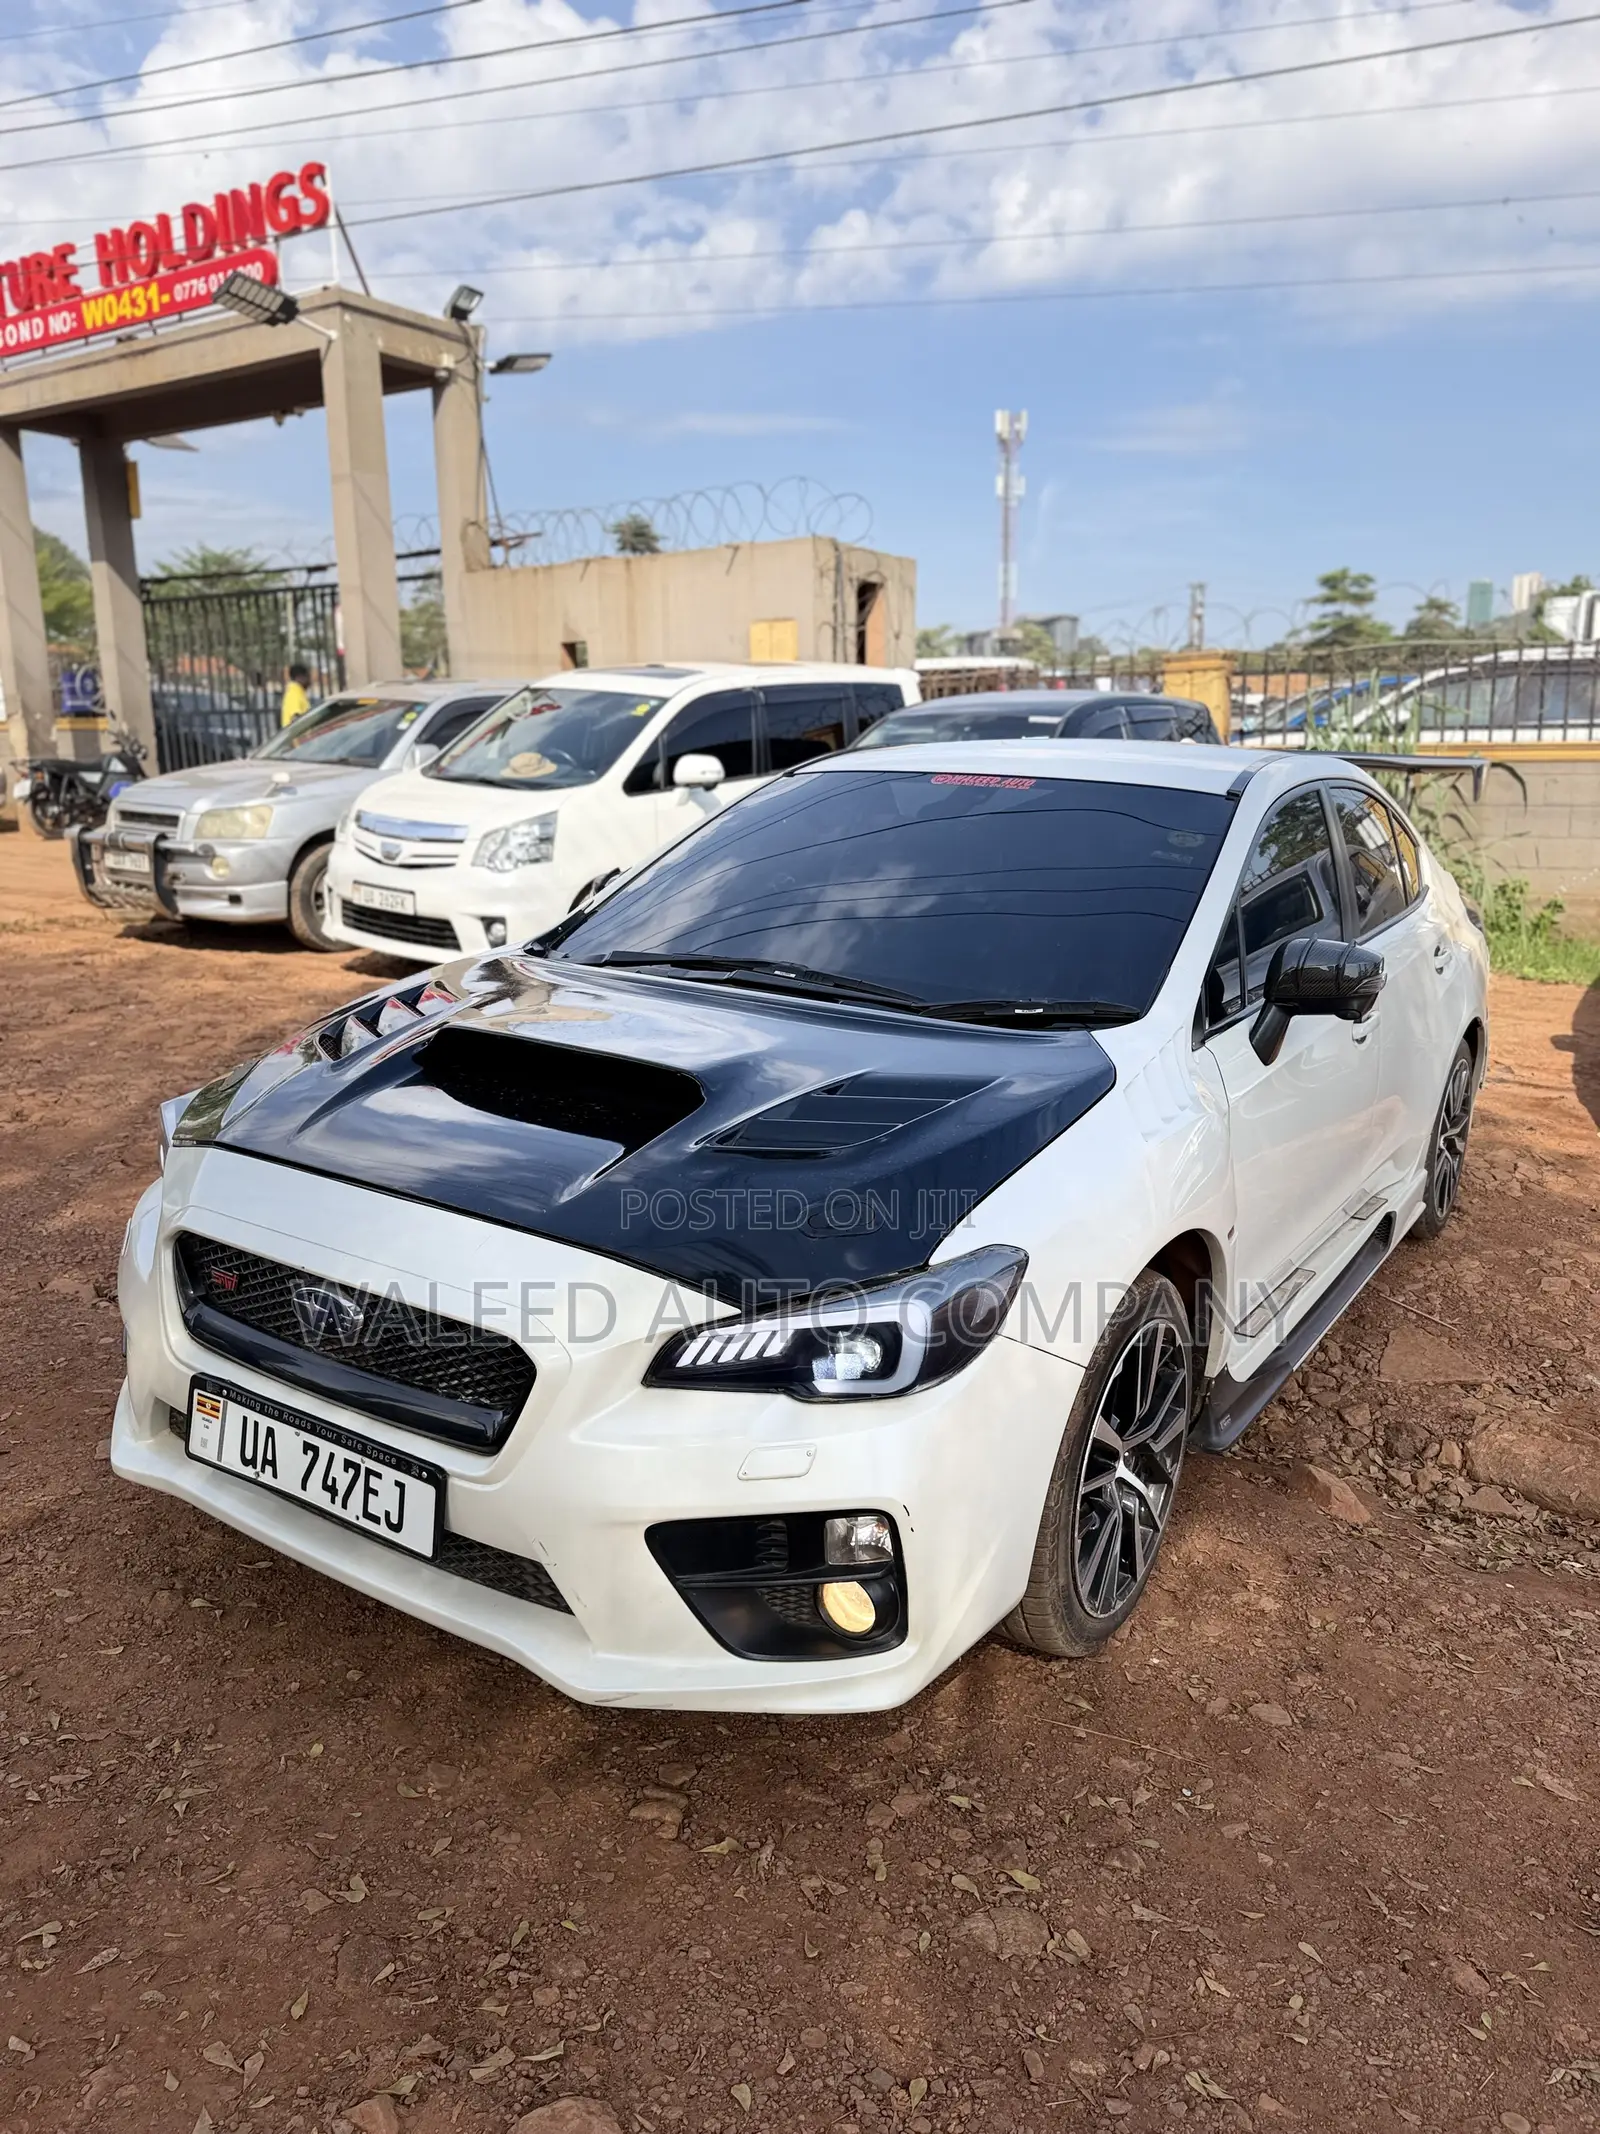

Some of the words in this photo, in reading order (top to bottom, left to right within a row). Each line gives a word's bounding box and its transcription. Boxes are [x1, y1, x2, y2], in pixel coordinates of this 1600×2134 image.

[95, 161, 330, 288] HOLDINGS
[48, 310, 77, 336] NO:
[173, 275, 208, 302] 0776
[229, 1389, 261, 1412] Making
[264, 1404, 279, 1417] the
[282, 1411, 312, 1430] Roads
[315, 1424, 338, 1440] Your
[340, 1434, 363, 1451] Safe
[366, 1445, 397, 1465] Space
[239, 1414, 278, 1480] UA
[300, 1440, 406, 1534] 747EJ
